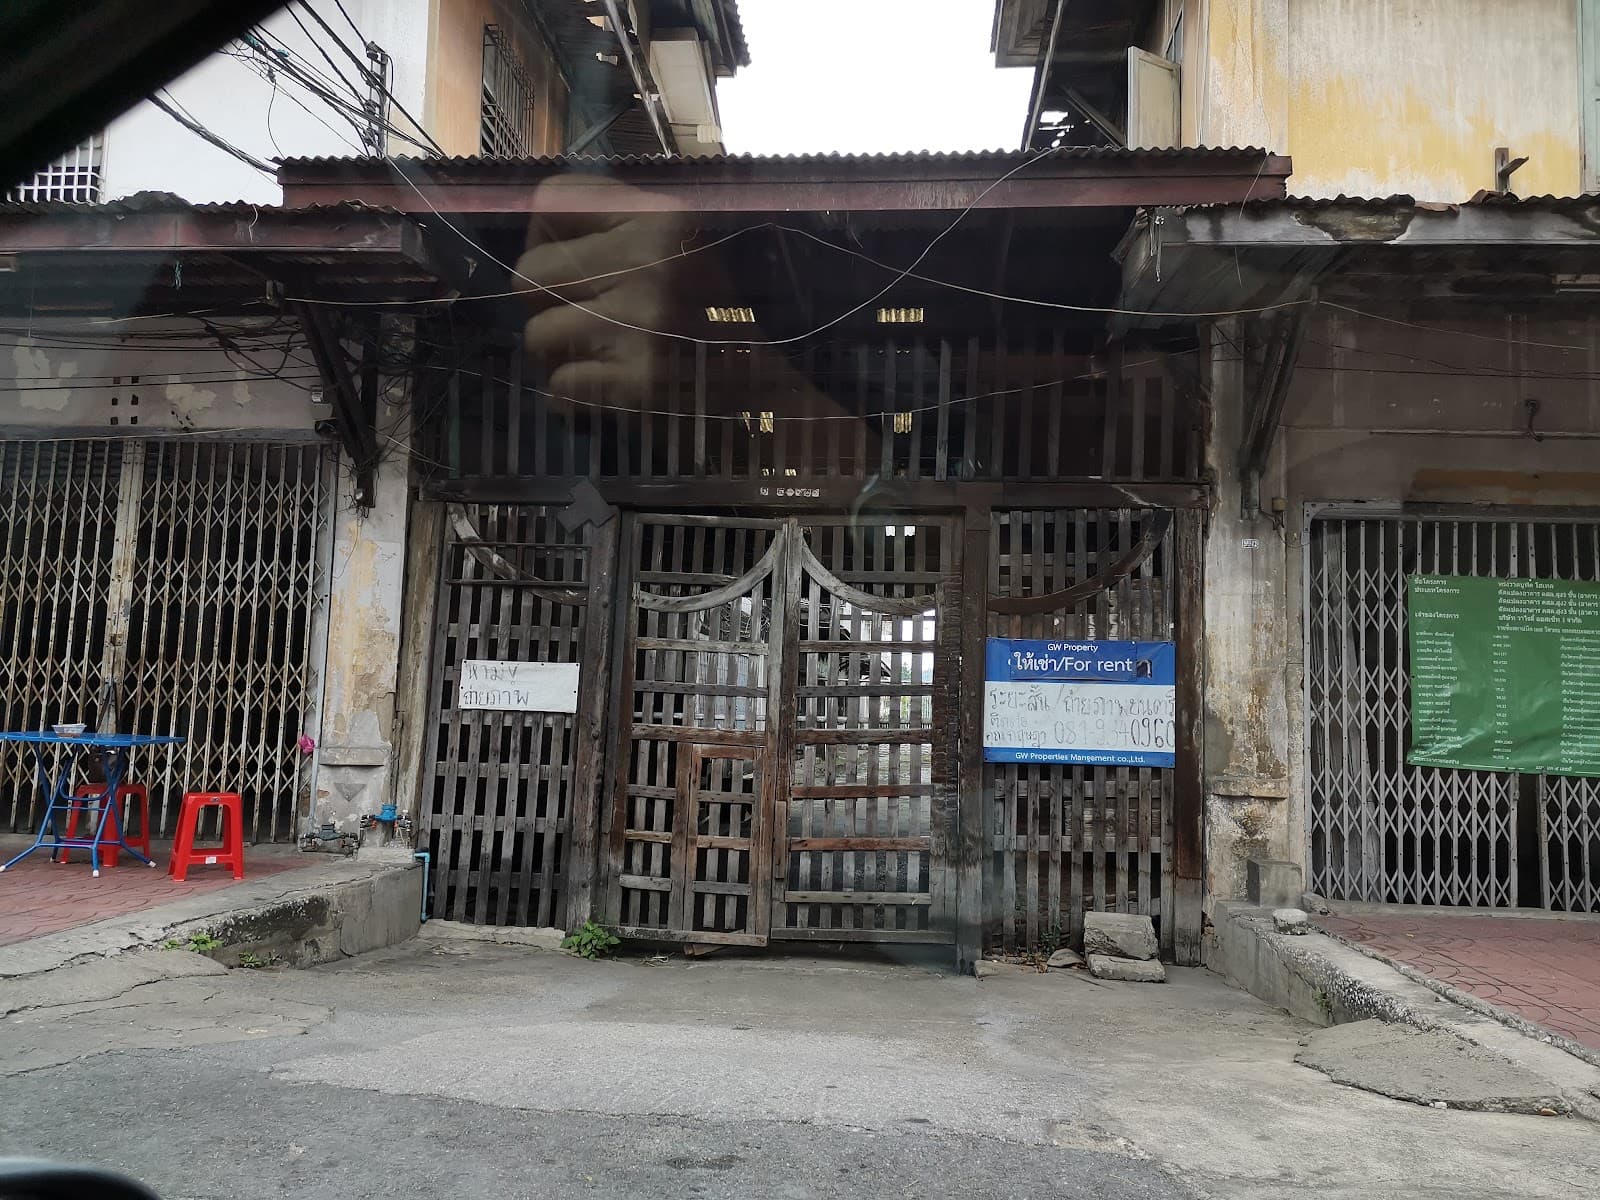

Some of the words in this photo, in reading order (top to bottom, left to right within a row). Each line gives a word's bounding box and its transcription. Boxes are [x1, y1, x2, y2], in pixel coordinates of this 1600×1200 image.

[1064, 644, 1099, 653] Property
[1097, 657, 1133, 672] rent
[1015, 752, 1028, 760] GW
[1030, 753, 1068, 762] Properties
